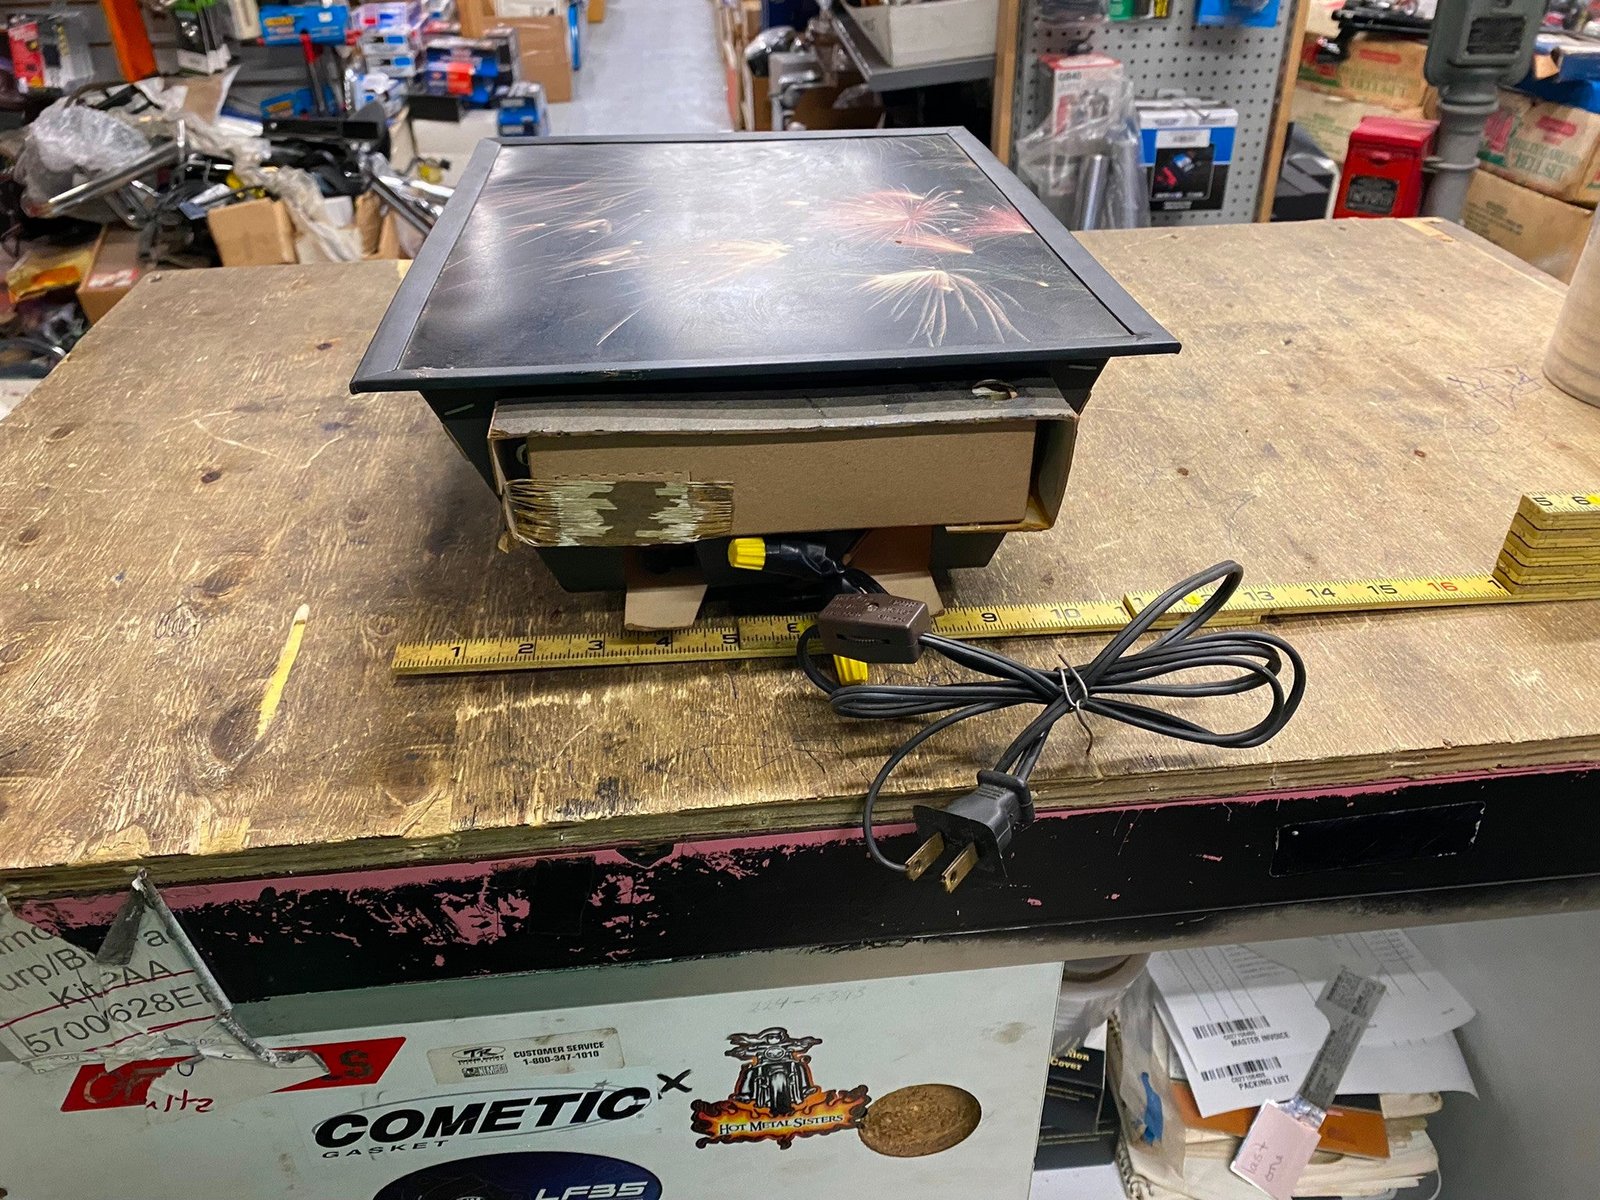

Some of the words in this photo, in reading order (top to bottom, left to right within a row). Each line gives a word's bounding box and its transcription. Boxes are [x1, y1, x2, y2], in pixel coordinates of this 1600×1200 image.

[1532, 495, 1553, 507] 5
[1571, 494, 1591, 506] 6
[450, 645, 461, 658] 1
[517, 642, 535, 655] 2
[587, 639, 604, 651] 3
[654, 635, 672, 648] 4
[722, 633, 738, 645] 5
[980, 611, 998, 623] 9
[1049, 607, 1082, 620] 10
[1242, 590, 1275, 602] 13
[1305, 586, 1337, 599] 14
[1366, 583, 1399, 596] 15
[1426, 580, 1459, 593] 16
[1486, 578, 1502, 590] 1
[1230, 1035, 1261, 1047] MASTER
[1260, 1031, 1290, 1042] INVOICE
[513, 1045, 565, 1059] CUSTOMER
[566, 1040, 605, 1053] SERVICE
[522, 1049, 600, 1066] 1-800-347-1010
[1050, 1056, 1083, 1071] Cover
[1238, 1077, 1273, 1091] PACKING
[1272, 1074, 1291, 1084] LIST
[314, 1086, 652, 1148] COMETIC
[719, 1123, 747, 1136] HOT
[749, 1120, 793, 1132] METAL
[793, 1114, 844, 1128] SISTERS
[321, 1139, 450, 1160] GASKET
